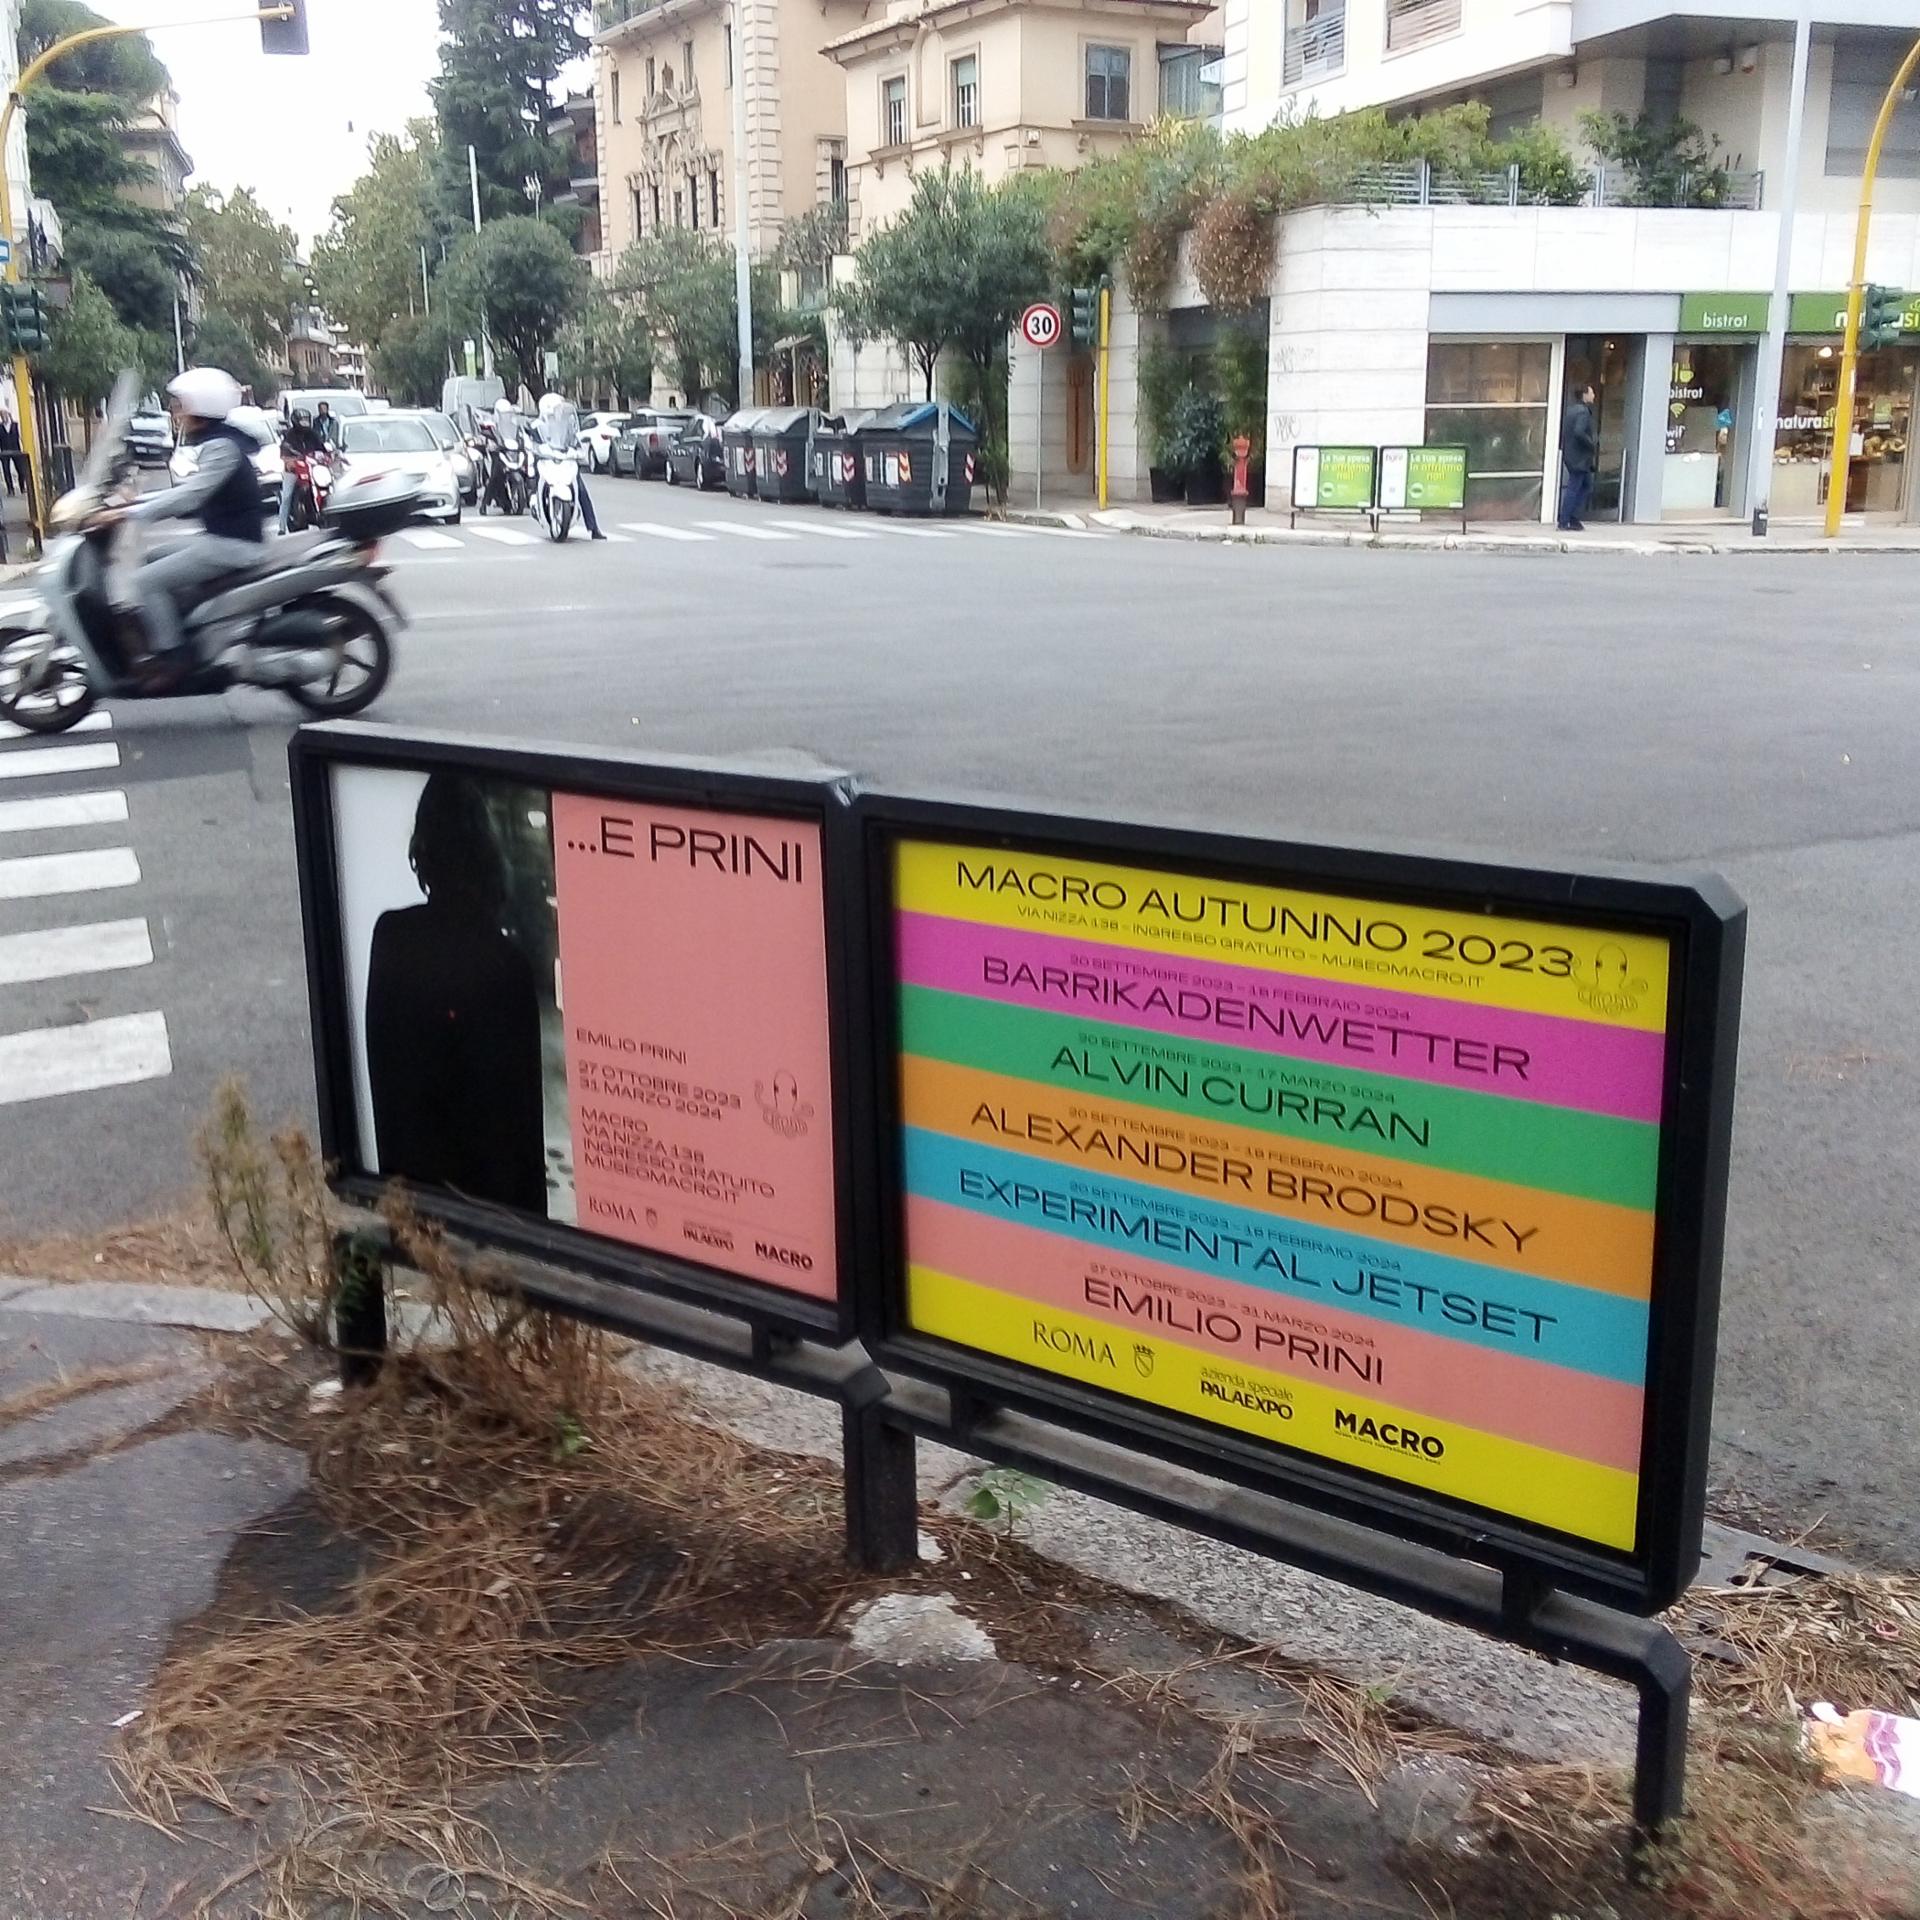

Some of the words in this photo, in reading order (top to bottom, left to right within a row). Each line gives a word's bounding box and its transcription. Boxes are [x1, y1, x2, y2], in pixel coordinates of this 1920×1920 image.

[1031, 316, 1052, 335] 30
[1703, 311, 1748, 328] bistrot
[567, 816, 635, 858] ...E
[650, 822, 802, 883] PRINI
[956, 861, 1128, 910] MACRO
[1138, 888, 1407, 952] AUTUNNO
[1422, 929, 1575, 977] 2023
[1017, 904, 1041, 918] VIA
[1043, 910, 1089, 928] NIZZA
[1132, 920, 1218, 948] INGRESSO
[1220, 937, 1306, 961] GRATUITO
[1321, 953, 1484, 988] MUSEOMACRO.IT
[1091, 956, 1190, 986] SETTEMBRE
[1191, 974, 1234, 993] 2023
[1272, 987, 1361, 1012] FEBBRAIO
[1364, 1004, 1411, 1022] 2024
[576, 1027, 637, 1054] EMILIO
[640, 1042, 687, 1065] PRINI
[982, 954, 1531, 1082] BARRIKADENWETTER
[601, 1065, 689, 1098] OTTOBRE
[693, 1085, 742, 1110] 2023
[1050, 1045, 1189, 1099] ALVIN
[1200, 1074, 1431, 1149] CURRAN
[1101, 1036, 1198, 1066] SETTEMBRE
[1200, 1057, 1242, 1074] 2023
[1258, 1067, 1276, 1082] 17
[1279, 1071, 1346, 1094] MARZO
[1349, 1085, 1396, 1105] 2024
[580, 1105, 649, 1133] MACRO
[603, 1081, 671, 1109] MARZO
[674, 1099, 722, 1121] 2024
[582, 1122, 609, 1140] VIA
[612, 1130, 667, 1156] NIZZA
[1090, 1109, 1186, 1143] SETTEMBRE
[1188, 1132, 1230, 1151] 2023
[1267, 1151, 1356, 1178] FEBBRAIO
[1358, 1170, 1404, 1188] 2024
[583, 1137, 676, 1172] INGRESSO
[679, 1162, 776, 1198] GRATUITO
[584, 1152, 739, 1204] MUSEOMACRO.IT
[970, 1101, 1254, 1192] ALEXANDER
[1266, 1169, 1539, 1253] BRODSKY
[588, 1196, 638, 1226] ROMA
[1090, 1183, 1186, 1221] SETTEMBRE
[1267, 1228, 1354, 1258] FEBBRAIO
[1357, 1252, 1401, 1272] 2024
[754, 1240, 814, 1271] MACRO
[959, 1167, 1322, 1287] EXPERIMENTAL
[1331, 1268, 1559, 1344] JETSET
[1083, 1276, 1242, 1344] EMILIO
[1254, 1325, 1383, 1386] PRINI
[1109, 1269, 1183, 1296] OTTOBRE
[1186, 1288, 1226, 1309] 2023
[1242, 1305, 1260, 1318] 31
[1262, 1308, 1329, 1335] MARZO
[1332, 1328, 1376, 1349] 2024
[1032, 1320, 1118, 1369] ROMA
[1200, 1367, 1246, 1388] azienda
[1248, 1381, 1294, 1402] speciale
[1200, 1379, 1294, 1420] PALAEXPO
[1334, 1408, 1445, 1459] MACRO
